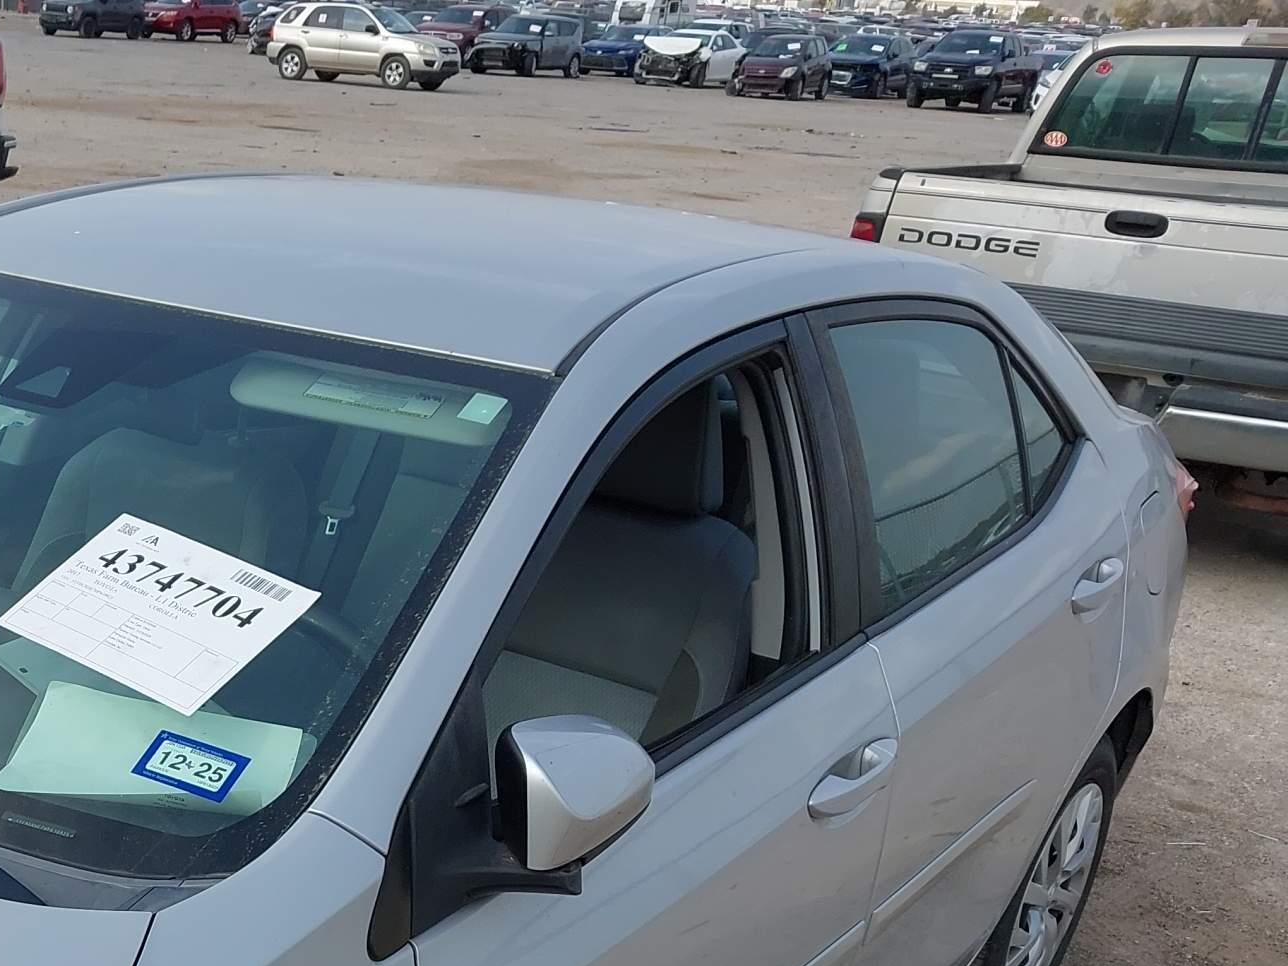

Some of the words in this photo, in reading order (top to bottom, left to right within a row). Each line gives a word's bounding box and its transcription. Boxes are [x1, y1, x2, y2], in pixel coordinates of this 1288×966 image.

[898, 227, 1041, 258] DODGE
[75, 560, 97, 575] Texas
[98, 569, 120, 584] Farm
[119, 579, 150, 597] Bureau
[98, 548, 265, 629] 43747704
[148, 604, 179, 620] COROLLA
[158, 751, 188, 771] 12
[193, 762, 227, 783] 25
